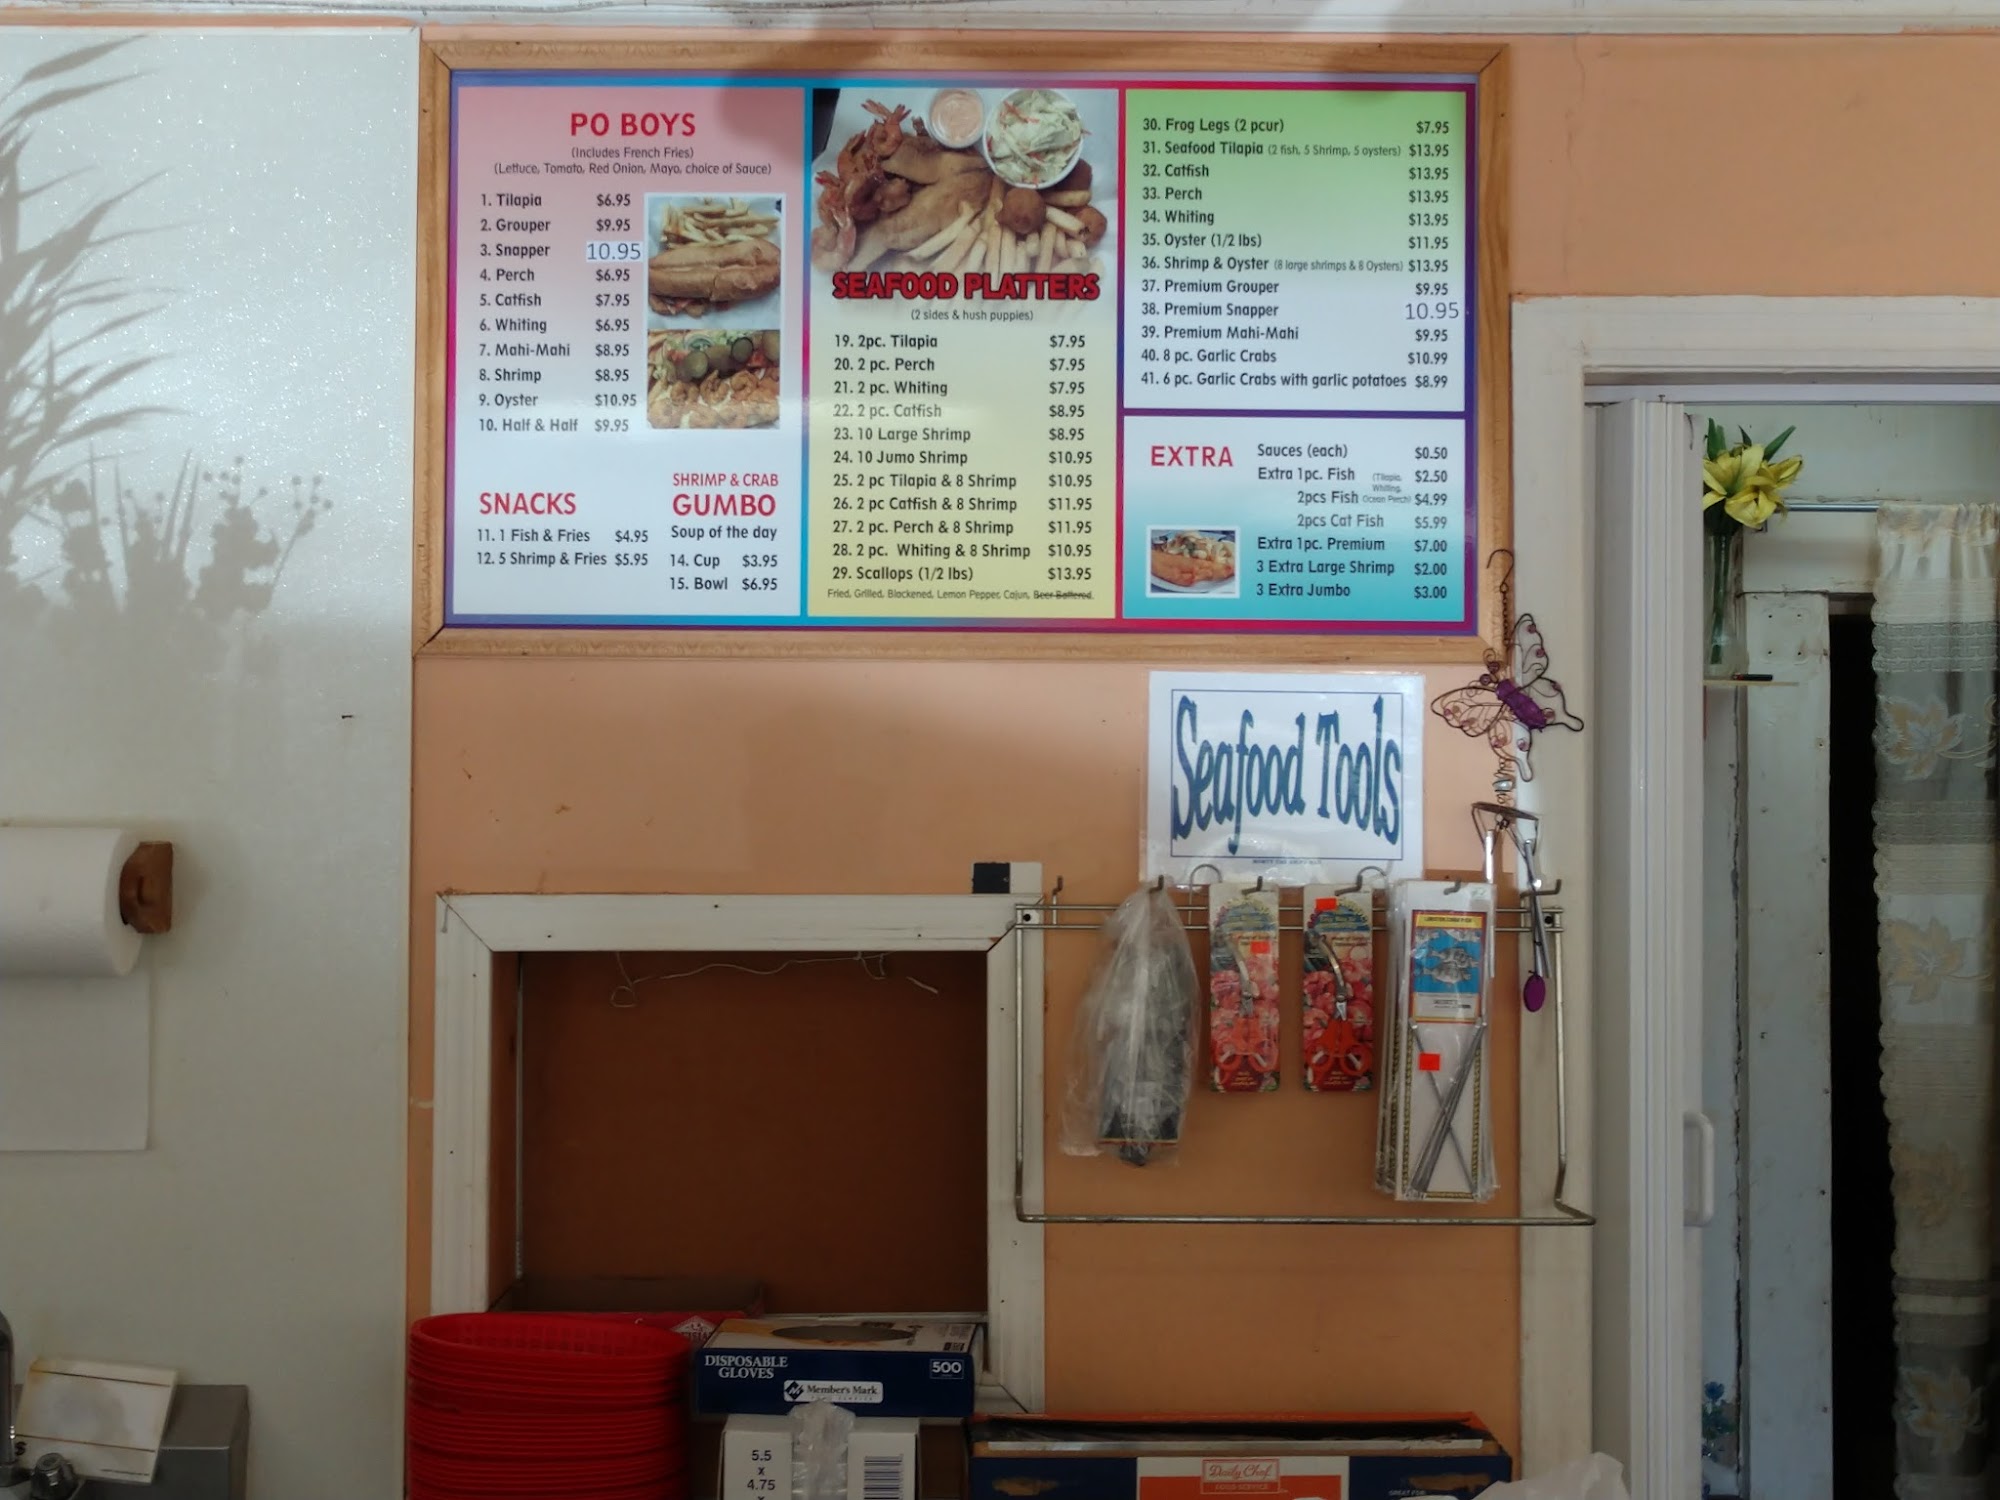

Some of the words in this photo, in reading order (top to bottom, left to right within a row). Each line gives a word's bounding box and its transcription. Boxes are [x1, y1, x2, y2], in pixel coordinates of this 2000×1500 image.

[571, 113, 609, 136] PO
[621, 113, 695, 136] BOYS
[1143, 118, 1160, 130] 30.
[1166, 118, 1194, 133] Frog
[1200, 118, 1229, 133] Legs
[1235, 119, 1246, 132] (2
[1251, 119, 1284, 134] pcur)
[1417, 121, 1449, 134] $7.95
[572, 147, 620, 158] (Includes
[624, 147, 660, 158] French
[664, 147, 693, 158] Fries)
[1143, 141, 1160, 154] 31.
[1165, 141, 1215, 154] Seafood
[1220, 141, 1263, 157] Tilapia
[1268, 144, 1277, 155] (2
[1280, 144, 1300, 155] fish,
[1304, 144, 1310, 155] 5
[1313, 145, 1350, 157] Shrimp,
[1354, 145, 1359, 156] 5
[1362, 146, 1401, 157] oysters)
[1409, 144, 1449, 157] $13.95
[494, 163, 540, 174] (Lettuce,
[544, 163, 585, 174] Tomato,
[589, 163, 609, 173] Red
[613, 163, 646, 174] Onion,
[650, 163, 682, 176] Mayo,
[686, 163, 719, 174] choice
[723, 163, 733, 174] of
[736, 163, 771, 174] Sauce)
[1143, 164, 1160, 176] 32.
[1165, 164, 1209, 177] Catfish
[1409, 167, 1448, 180] $13.95
[482, 194, 491, 206] 1.
[497, 194, 541, 208] Tilapia
[597, 194, 630, 206] $6.95
[481, 219, 491, 231] 2.
[496, 218, 550, 233] Grouper
[597, 219, 630, 232] $9.95
[1143, 210, 1160, 222] 34.
[1165, 210, 1214, 225] Whiting
[1409, 213, 1448, 226] $13.95
[480, 244, 491, 256] 3.
[496, 244, 550, 258] Snapper
[588, 243, 640, 260] 10.95
[480, 269, 491, 281] 4.
[497, 268, 534, 281] Perch
[596, 269, 630, 281] $6.95
[832, 272, 958, 300] SEAFOOD
[964, 272, 1100, 300] PLATTERS
[1142, 279, 1159, 292] 37.
[1165, 279, 1222, 292] Premium
[1227, 280, 1279, 295] Grouper
[1416, 283, 1448, 295] $9.95
[480, 294, 490, 306] 5.
[495, 293, 541, 306] Catfish
[596, 294, 629, 306] $7.95
[911, 309, 920, 320] (2
[923, 309, 949, 320] sides
[952, 309, 959, 320] &
[963, 310, 987, 320] hush
[990, 311, 1033, 322] puppies)
[1142, 302, 1159, 315] 38.
[1165, 303, 1222, 315] Premium
[1227, 303, 1278, 318] Snapper
[1406, 302, 1459, 320] 10.95
[480, 319, 490, 331] 6.
[496, 319, 546, 334] Whiting
[596, 319, 629, 332] $6.95
[1142, 325, 1159, 338] 39.
[1165, 326, 1221, 338] Premium
[1227, 326, 1298, 339] Mahi-Mahi
[1416, 329, 1448, 341] $9.95
[835, 335, 853, 347] 19.
[859, 335, 885, 349] 2pc.
[891, 335, 937, 350] Tilapia
[1050, 335, 1085, 348] $7.95
[480, 344, 490, 356] 7.
[495, 344, 569, 356] Mahi-Mahi
[596, 344, 629, 357] $8.95
[835, 358, 853, 370] 20.
[858, 358, 865, 370] 2
[870, 361, 889, 373] pc.
[895, 358, 934, 370] Perch
[1050, 358, 1085, 371] $7.95
[480, 368, 490, 381] 8.
[495, 369, 541, 383] Shrimp
[595, 369, 629, 381] $8.95
[479, 394, 489, 406] 9.
[495, 393, 538, 408] Oyster
[595, 394, 636, 406] $10.95
[480, 419, 497, 431] 10.
[503, 419, 530, 431] Half
[535, 418, 544, 431] &
[550, 419, 578, 431] Half
[595, 419, 628, 432] $9.95
[834, 451, 852, 463] 24.
[858, 451, 872, 463] 10
[877, 451, 914, 463] Jumo
[920, 451, 967, 466] Shrimp
[1049, 451, 1092, 464] $10.95
[1152, 446, 1232, 466] EXTRA
[1258, 444, 1302, 456] Sauces
[1308, 444, 1347, 458] (each)
[1415, 447, 1447, 459] $0.50
[674, 473, 726, 486] SHRIMP
[730, 474, 739, 486] &
[743, 474, 778, 486] CRAB
[480, 493, 576, 514] SNACKS
[673, 494, 775, 516] GUMBO
[1297, 514, 1326, 530] 2pcs
[1331, 514, 1352, 527] Cat
[1357, 514, 1384, 527] Fish
[1415, 516, 1447, 529] $5.99
[672, 525, 704, 540] Soup
[709, 526, 722, 538] of
[727, 526, 748, 538] the
[753, 526, 777, 541] day
[671, 554, 689, 566] 14.
[694, 554, 720, 569] Cup
[743, 555, 777, 567] $3.95
[833, 567, 851, 579] 29.
[857, 566, 913, 582] Scallops
[919, 567, 943, 581] (1/2
[949, 567, 973, 581] lbs)
[1048, 567, 1091, 580] $13.95
[670, 577, 688, 589] 15.
[695, 577, 727, 590] Bowl
[742, 578, 777, 590] $6.95
[1174, 695, 1305, 855] Seafood
[1316, 694, 1400, 845] Tools
[705, 1355, 788, 1368] DISPOSABLE
[932, 1361, 962, 1373] 500
[718, 1367, 774, 1379] GLOVES
[807, 1384, 850, 1395] Member's
[853, 1384, 877, 1395] Mark
[752, 1450, 772, 1461] 5.5
[747, 1479, 775, 1490] 4.75
